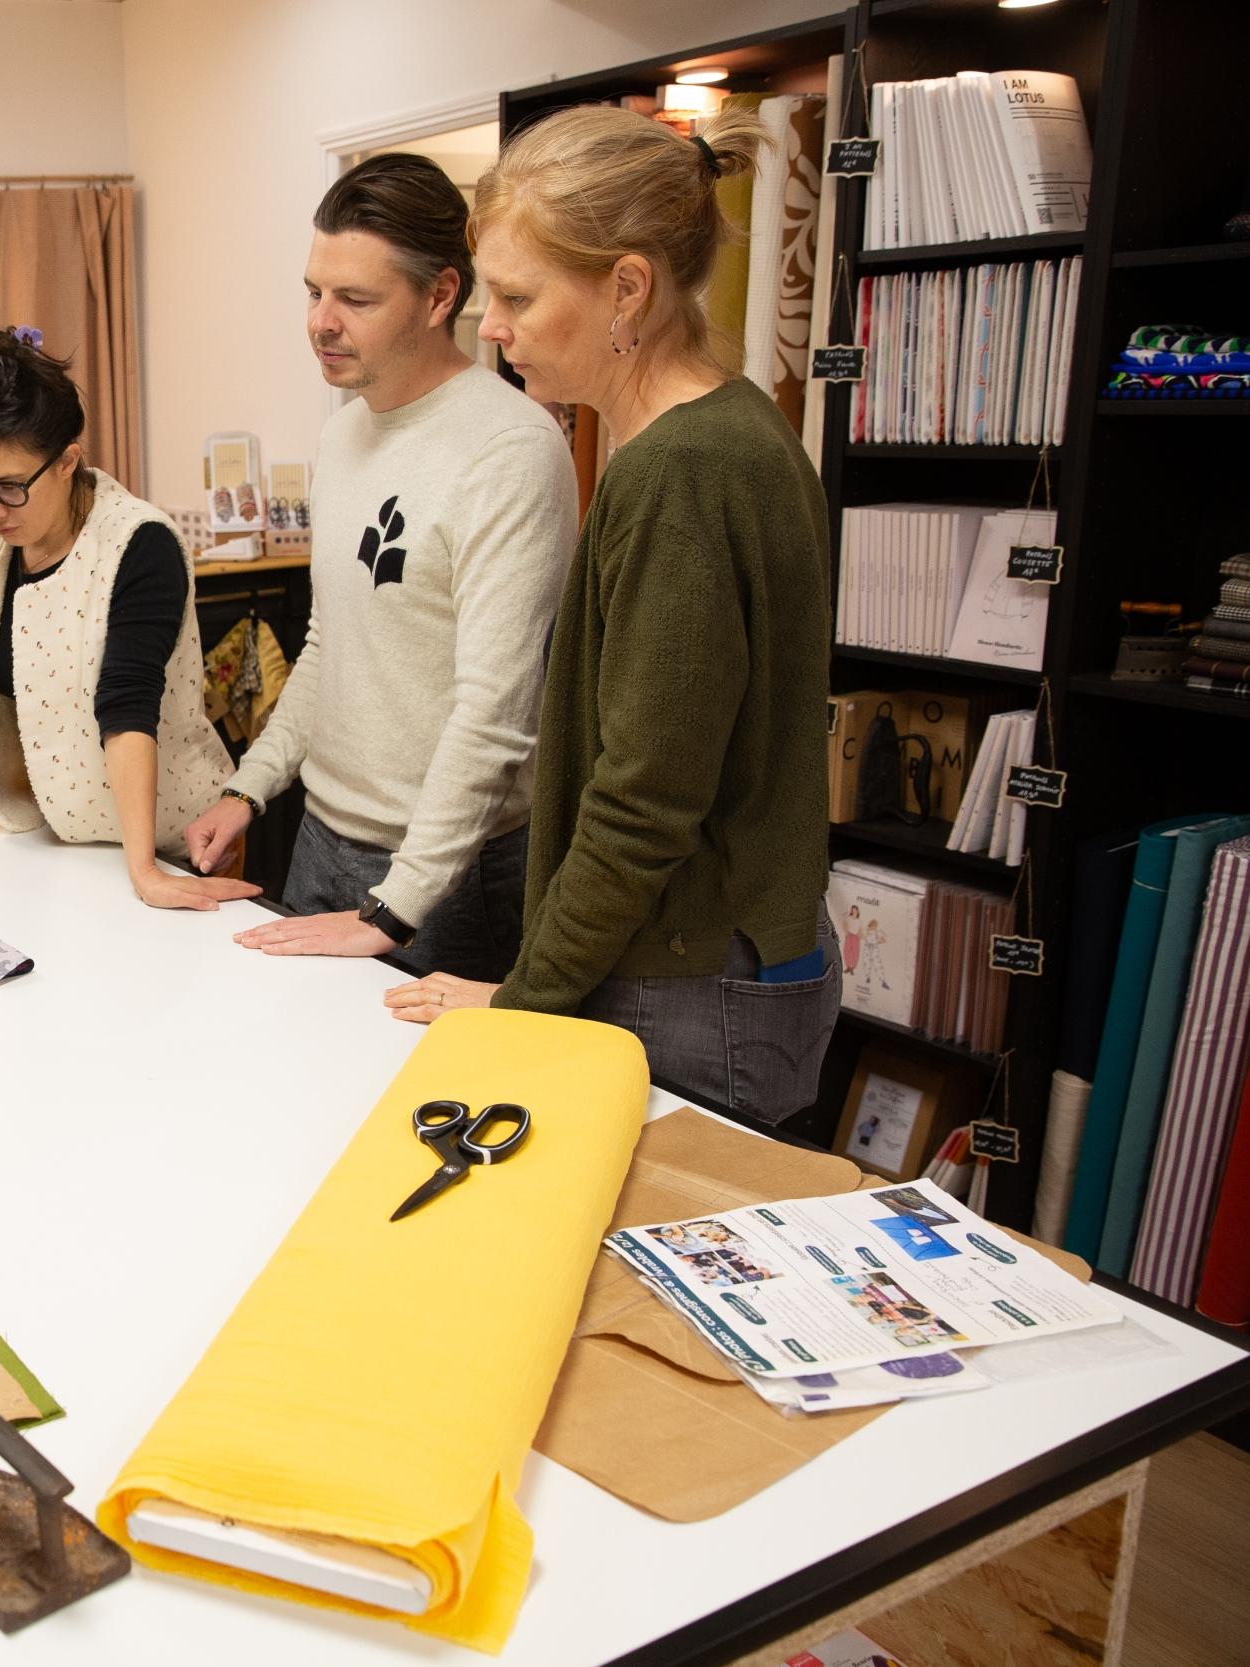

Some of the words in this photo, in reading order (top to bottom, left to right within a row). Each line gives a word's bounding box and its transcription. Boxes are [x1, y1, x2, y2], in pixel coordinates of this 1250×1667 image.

[1003, 80, 1008, 89] I
[1011, 80, 1029, 89] AM
[1007, 93, 1045, 103] LOTUS
[942, 747, 962, 770] M
[671, 1286, 716, 1328] consignes
[716, 1330, 752, 1360] Photos
